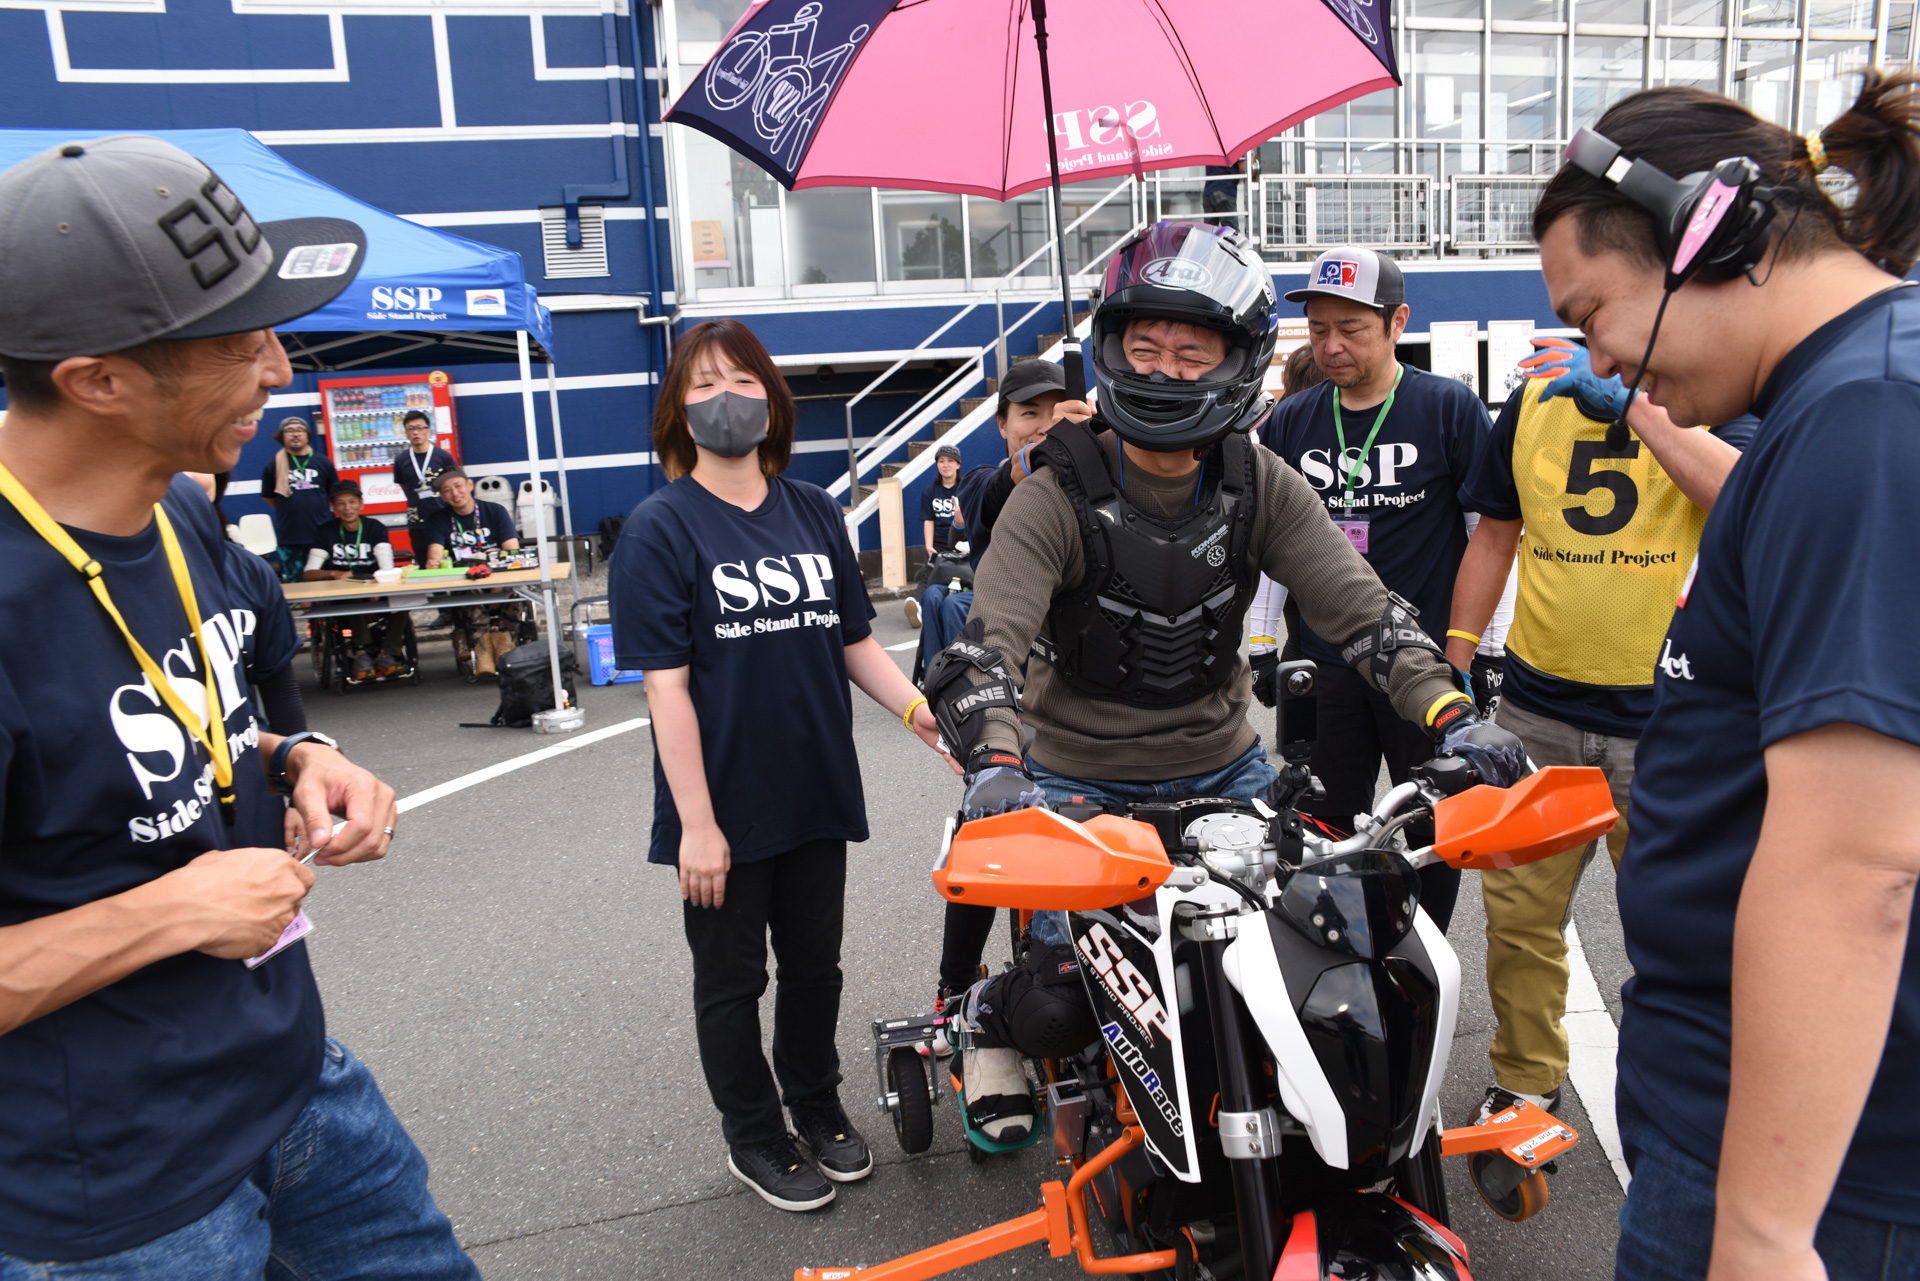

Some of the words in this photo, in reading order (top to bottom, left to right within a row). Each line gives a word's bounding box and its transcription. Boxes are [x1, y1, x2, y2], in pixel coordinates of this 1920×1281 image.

[1145, 261, 1202, 281] Arai
[371, 286, 443, 311] SSP
[366, 312, 387, 320] Side
[388, 312, 414, 320] Stand
[416, 312, 447, 321] Project
[1300, 442, 1418, 490] SSP
[1328, 494, 1369, 508] Stnd
[1373, 489, 1426, 508] Project
[1562, 440, 1640, 536] 5
[332, 542, 372, 559] SSP
[1191, 524, 1228, 556] KOMINE
[1533, 546, 1553, 561] Side
[1555, 549, 1604, 564] Stand
[1610, 549, 1677, 568] Project
[712, 553, 834, 614] SSP
[714, 622, 752, 639] Side
[753, 612, 800, 634] Stand
[802, 610, 840, 628] Proje
[128, 798, 202, 843] Side
[1073, 942, 1090, 967] SIDE
[1089, 966, 1118, 1003] STAND
[1117, 1001, 1156, 1050] PROJECT
[1077, 921, 1173, 1046] SSP
[1100, 1020, 1185, 1138] AutoRace
